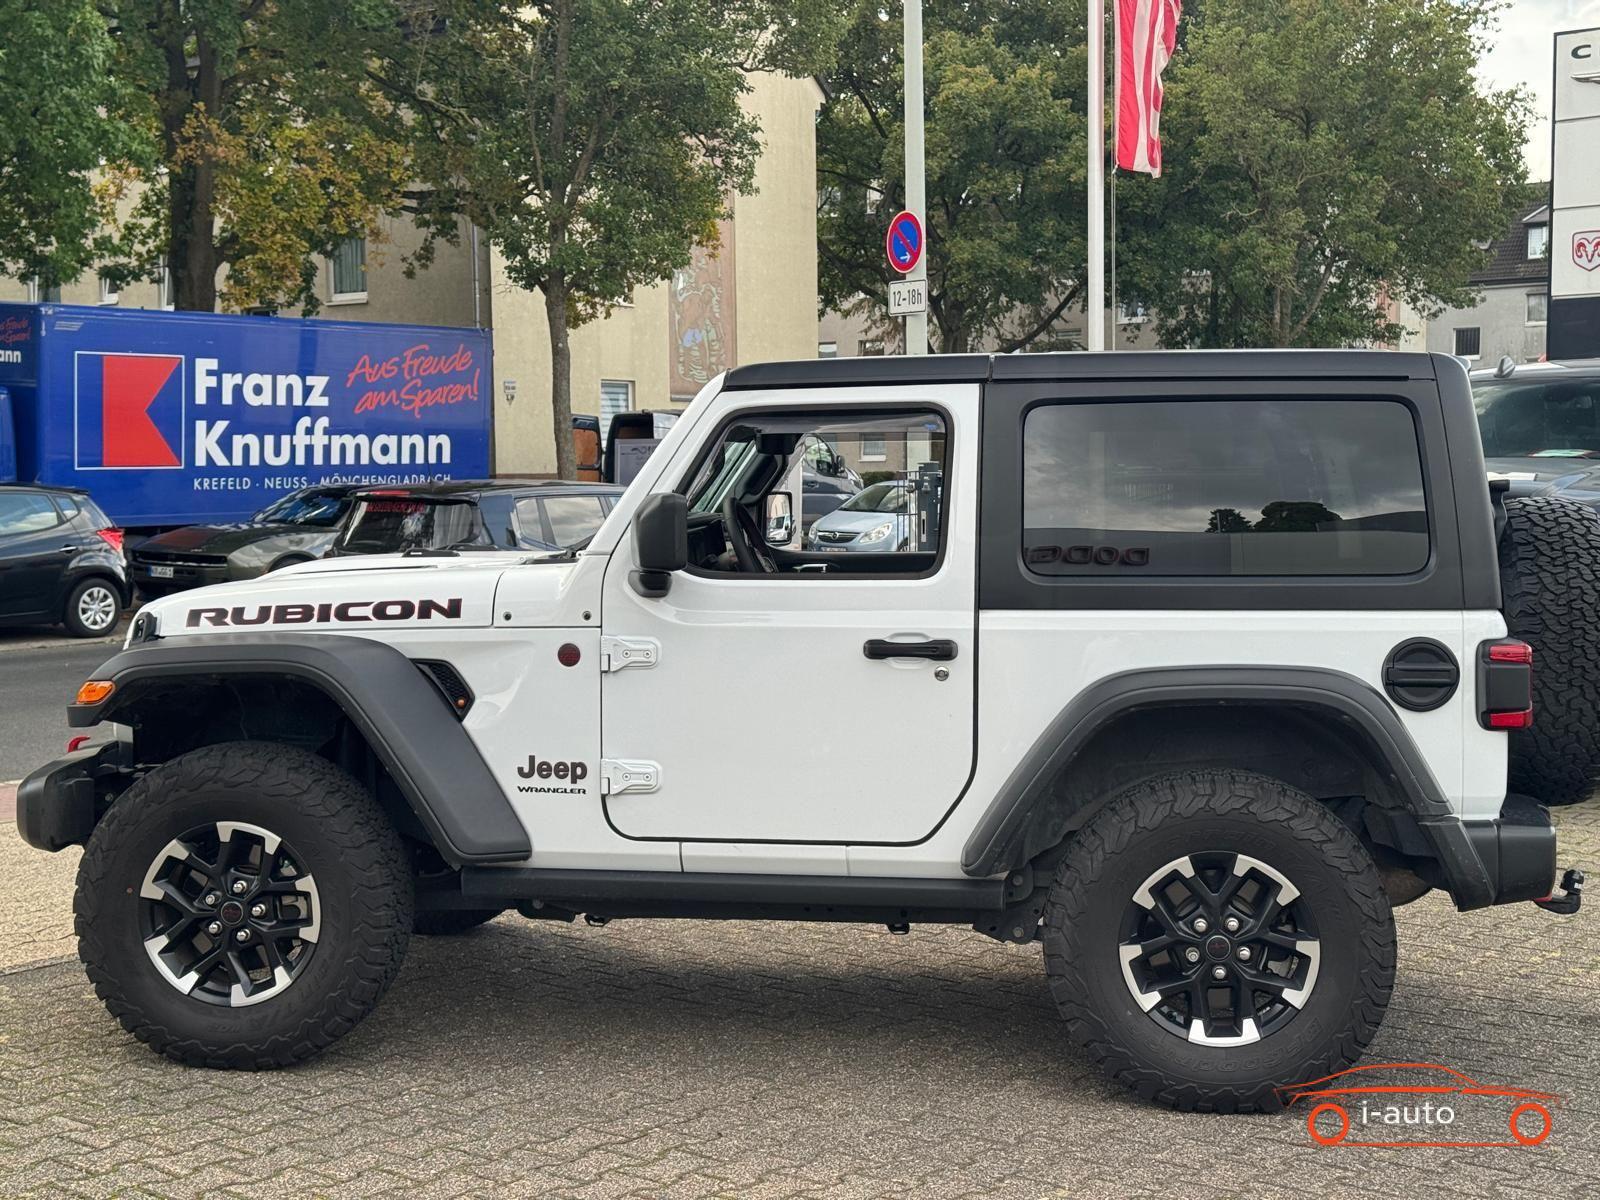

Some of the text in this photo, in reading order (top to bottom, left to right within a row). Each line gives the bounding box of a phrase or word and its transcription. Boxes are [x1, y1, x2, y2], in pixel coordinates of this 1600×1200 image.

[893, 288, 922, 308] 12-18h
[346, 343, 473, 388] Aus Freude
[194, 357, 330, 406] Franz
[353, 389, 400, 414] am
[400, 368, 480, 418] Sparen!
[194, 415, 451, 467] Knuffmann
[193, 476, 251, 490] KREFELD
[264, 476, 308, 489] NEUSS
[186, 598, 463, 628] RUBICON
[517, 754, 588, 785] Jeep
[517, 785, 587, 795] WRANGLER
